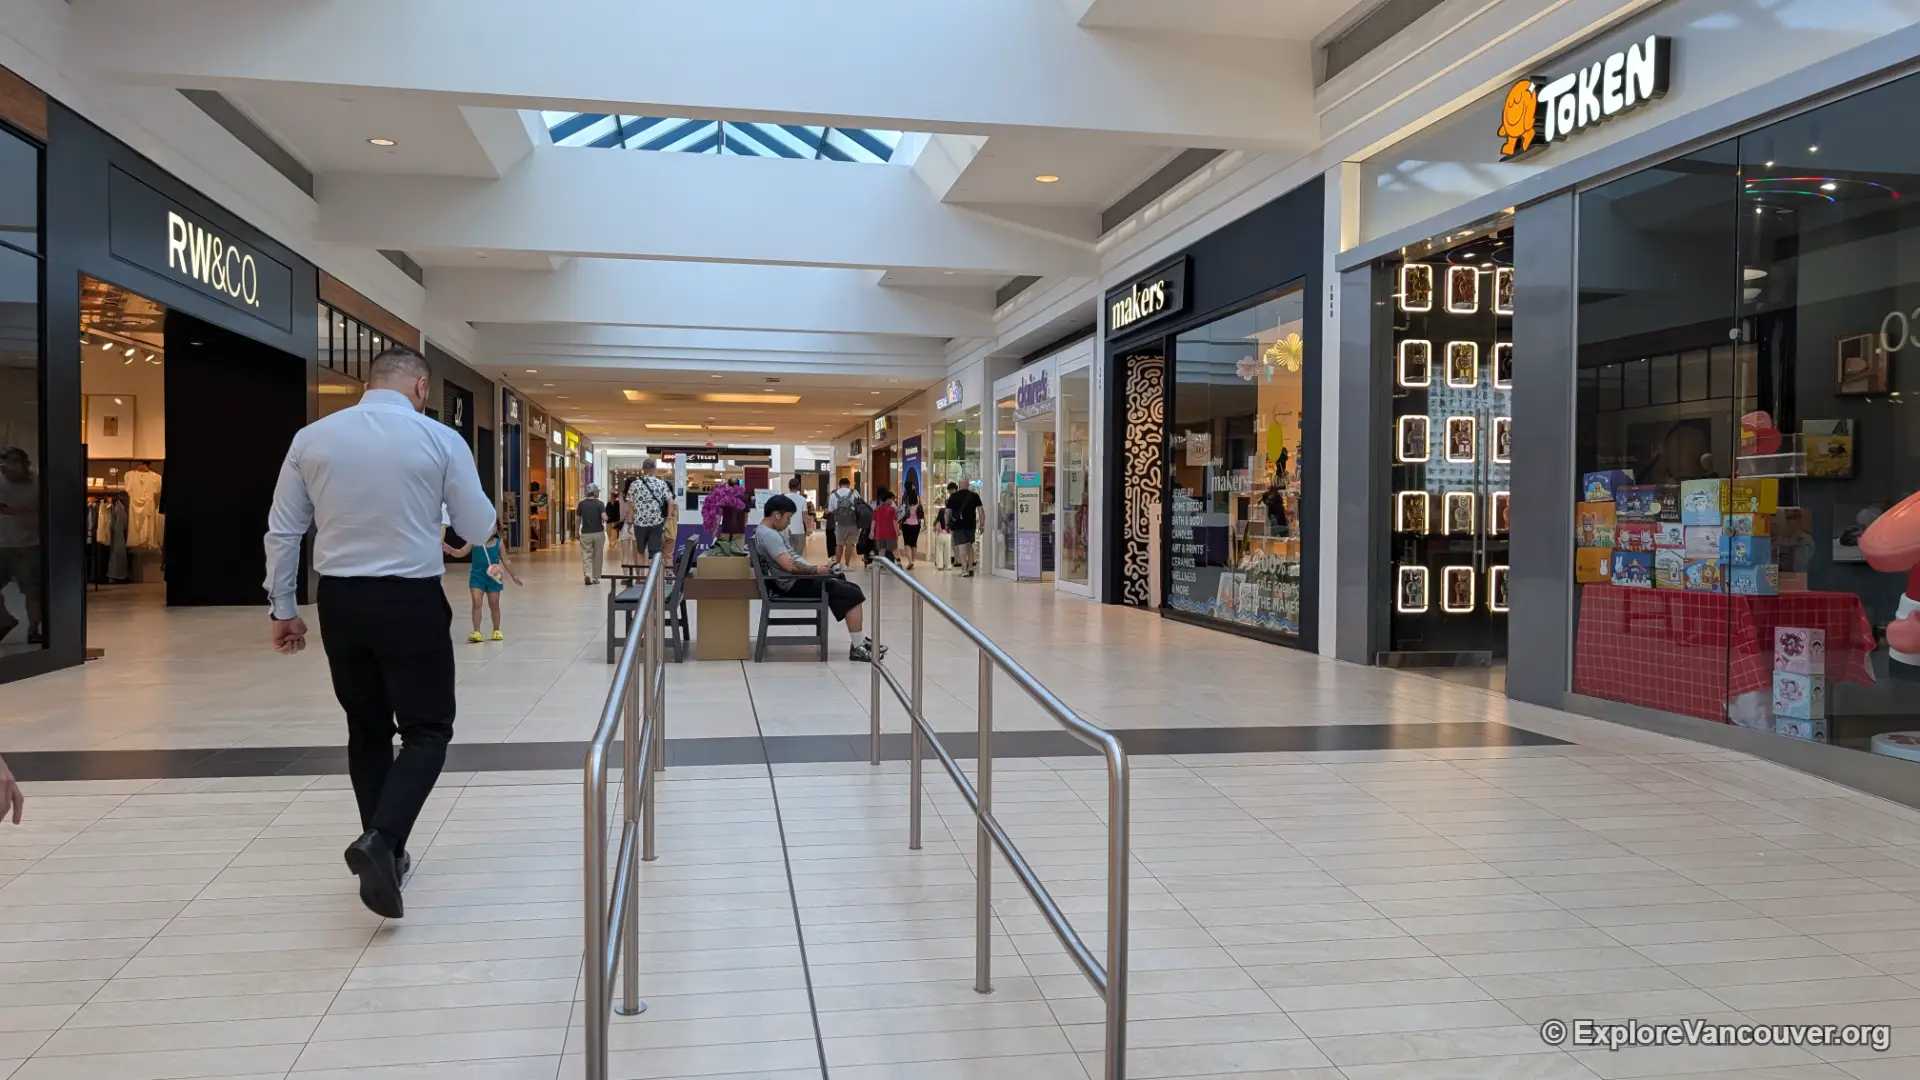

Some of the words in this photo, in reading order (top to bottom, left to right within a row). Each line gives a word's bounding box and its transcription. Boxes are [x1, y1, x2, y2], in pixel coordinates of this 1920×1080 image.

[167, 210, 260, 308] RW&CO.
[1112, 279, 1164, 330] makers
[1211, 470, 1249, 492] makers
[1172, 501, 1185, 512] HOME
[1172, 516, 1185, 526] BATH
[1190, 516, 1204, 526] BODY
[1172, 530, 1194, 540] CANDLES
[1172, 544, 1181, 553] ART
[1186, 544, 1204, 555] PRINTS
[1172, 557, 1195, 568] CERAMICS
[1172, 571, 1196, 582] WELLNESS
[1176, 584, 1190, 596] MORE
[1257, 580, 1272, 592] SALE
